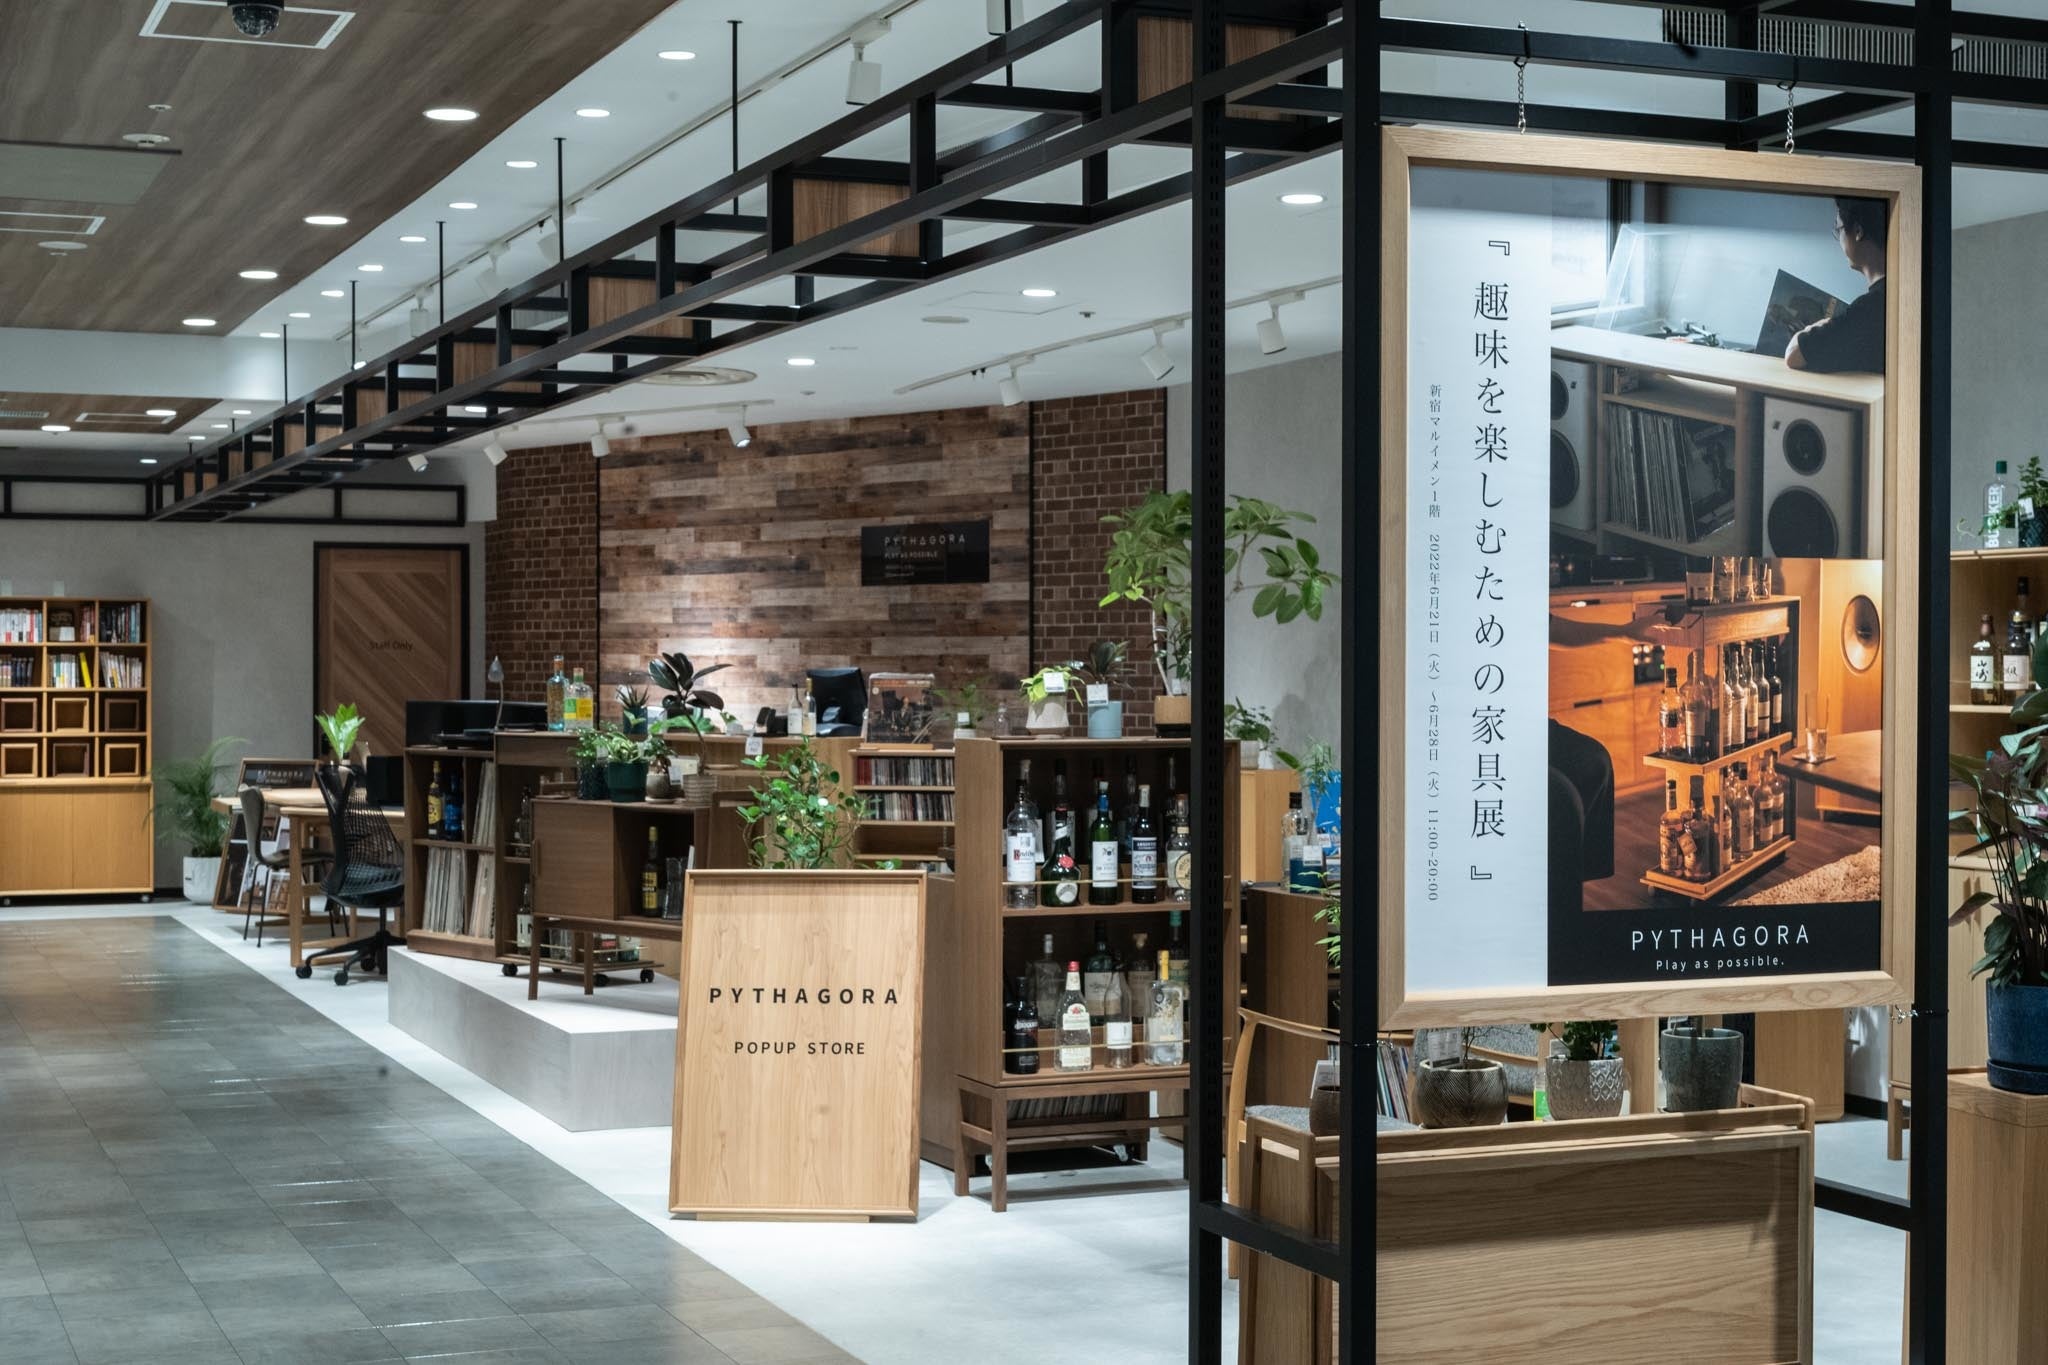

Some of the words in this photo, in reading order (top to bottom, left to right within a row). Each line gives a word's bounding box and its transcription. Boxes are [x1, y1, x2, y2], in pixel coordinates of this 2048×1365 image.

[1632, 924, 1809, 951] PYTHAGORA
[1656, 959, 1686, 973] Play
[1695, 959, 1709, 969] as
[1717, 955, 1784, 970] possible.
[709, 987, 898, 1004] PYTHAGORA
[734, 1041, 796, 1055] POPUP
[807, 1041, 865, 1055] STORE
